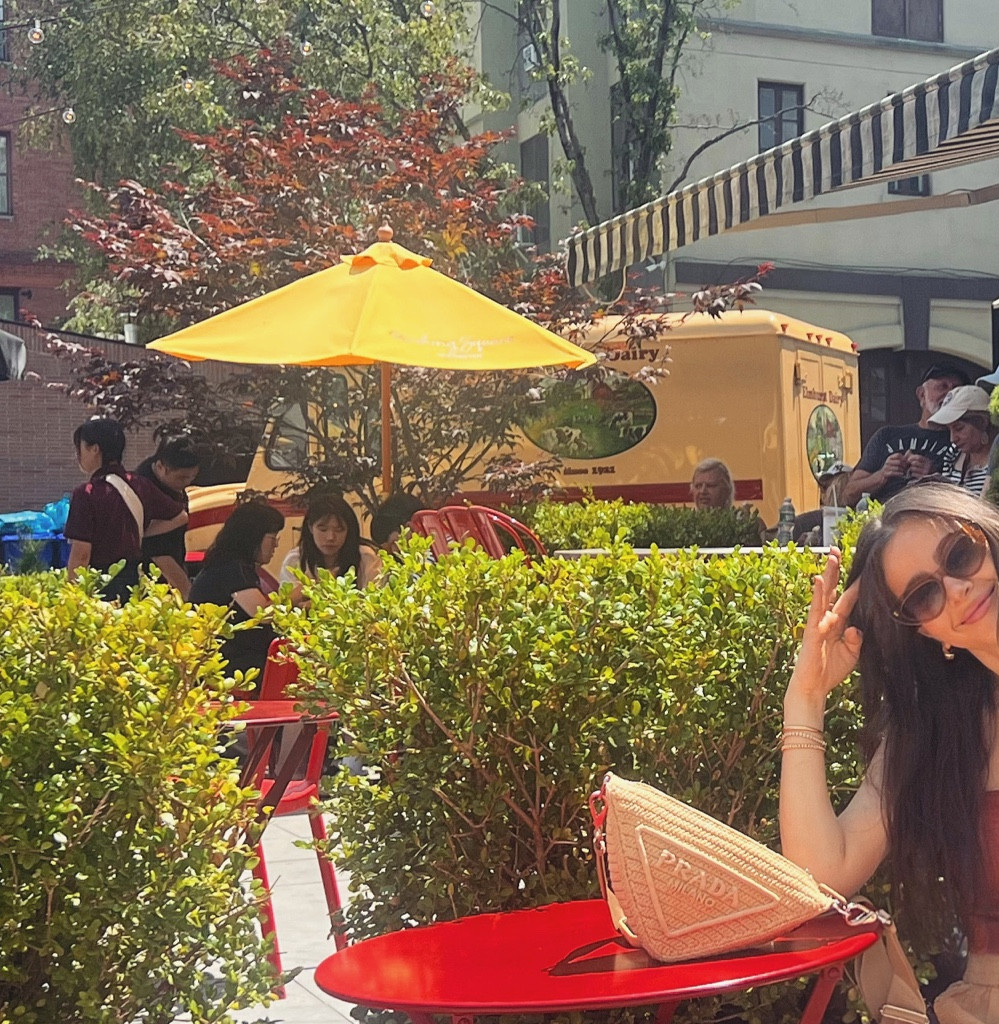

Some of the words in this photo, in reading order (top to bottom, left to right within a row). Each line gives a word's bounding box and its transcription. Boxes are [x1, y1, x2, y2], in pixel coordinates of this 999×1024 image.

[885, 437, 948, 456] JAMAIC
[657, 848, 740, 902] PRADA
[668, 881, 714, 906] MILANO
